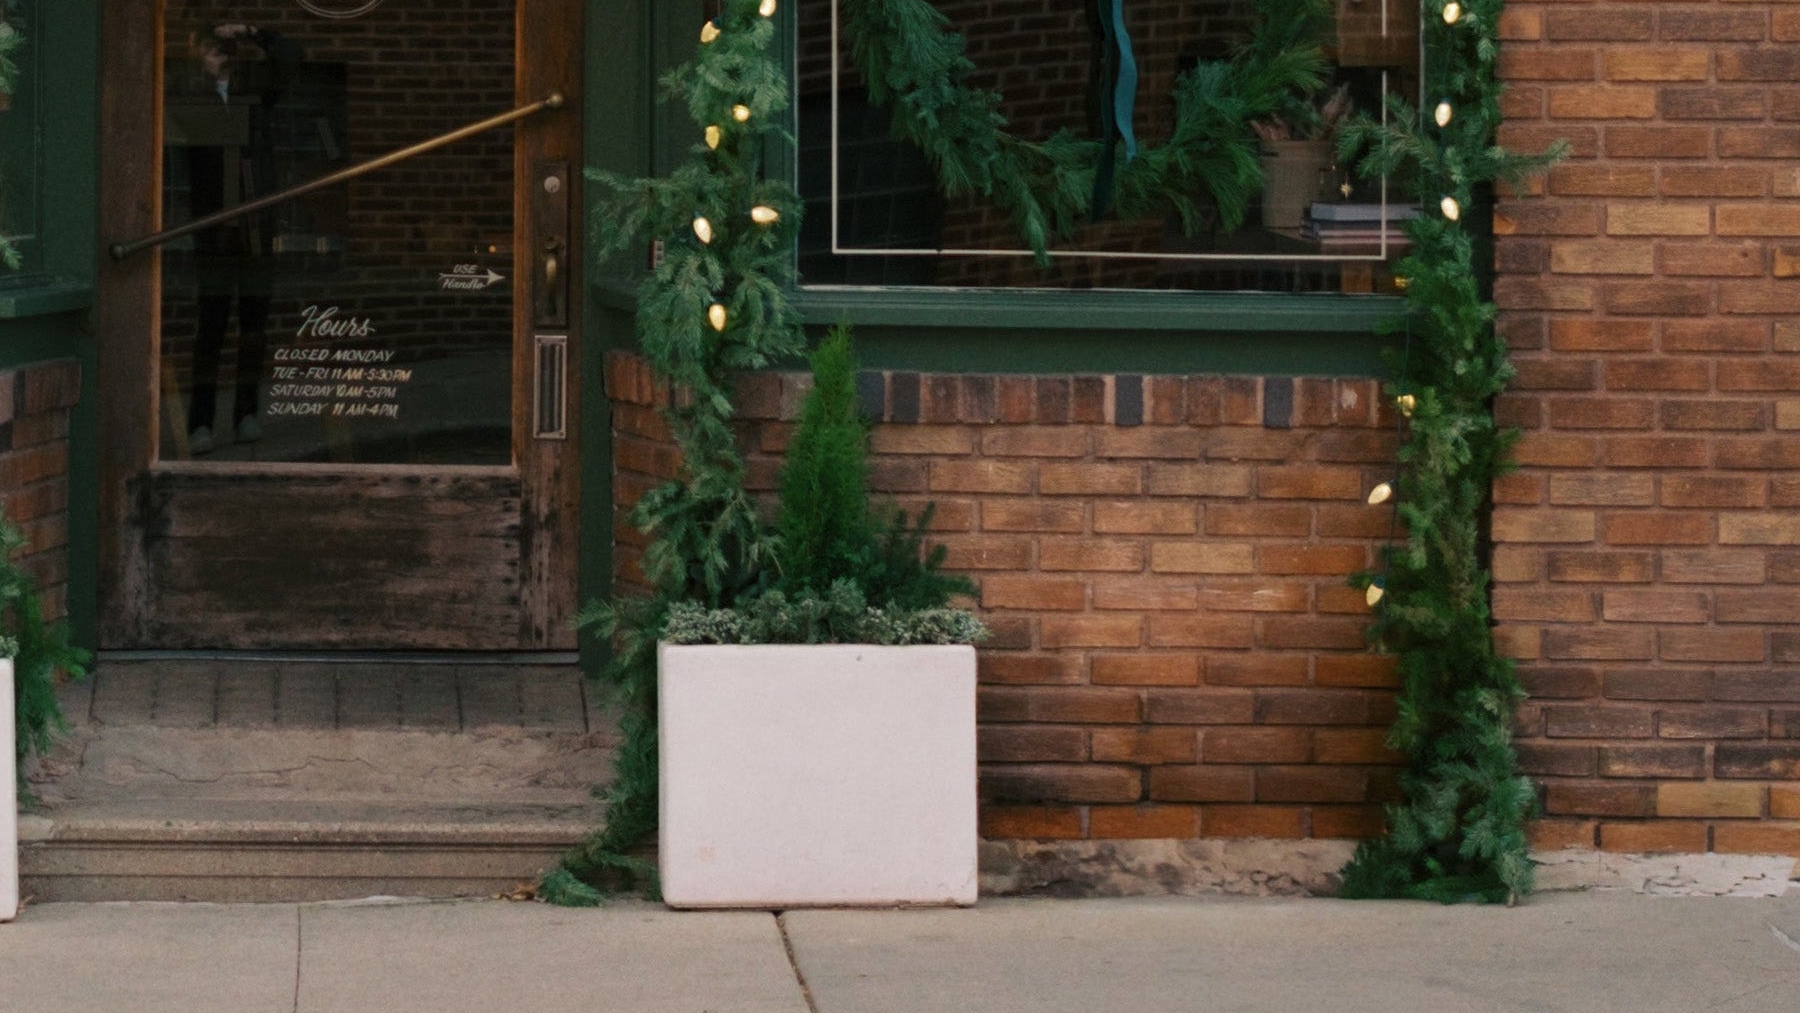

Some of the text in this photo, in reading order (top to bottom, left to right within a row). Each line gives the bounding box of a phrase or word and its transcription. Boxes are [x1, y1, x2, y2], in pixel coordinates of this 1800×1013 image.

[452, 263, 479, 274] USE
[442, 278, 488, 290] Handle
[296, 304, 376, 337] Hours
[274, 348, 395, 363] CLOSED MONDAY
[269, 383, 335, 397] SATURDAY
[266, 401, 328, 416] SUNDAY
